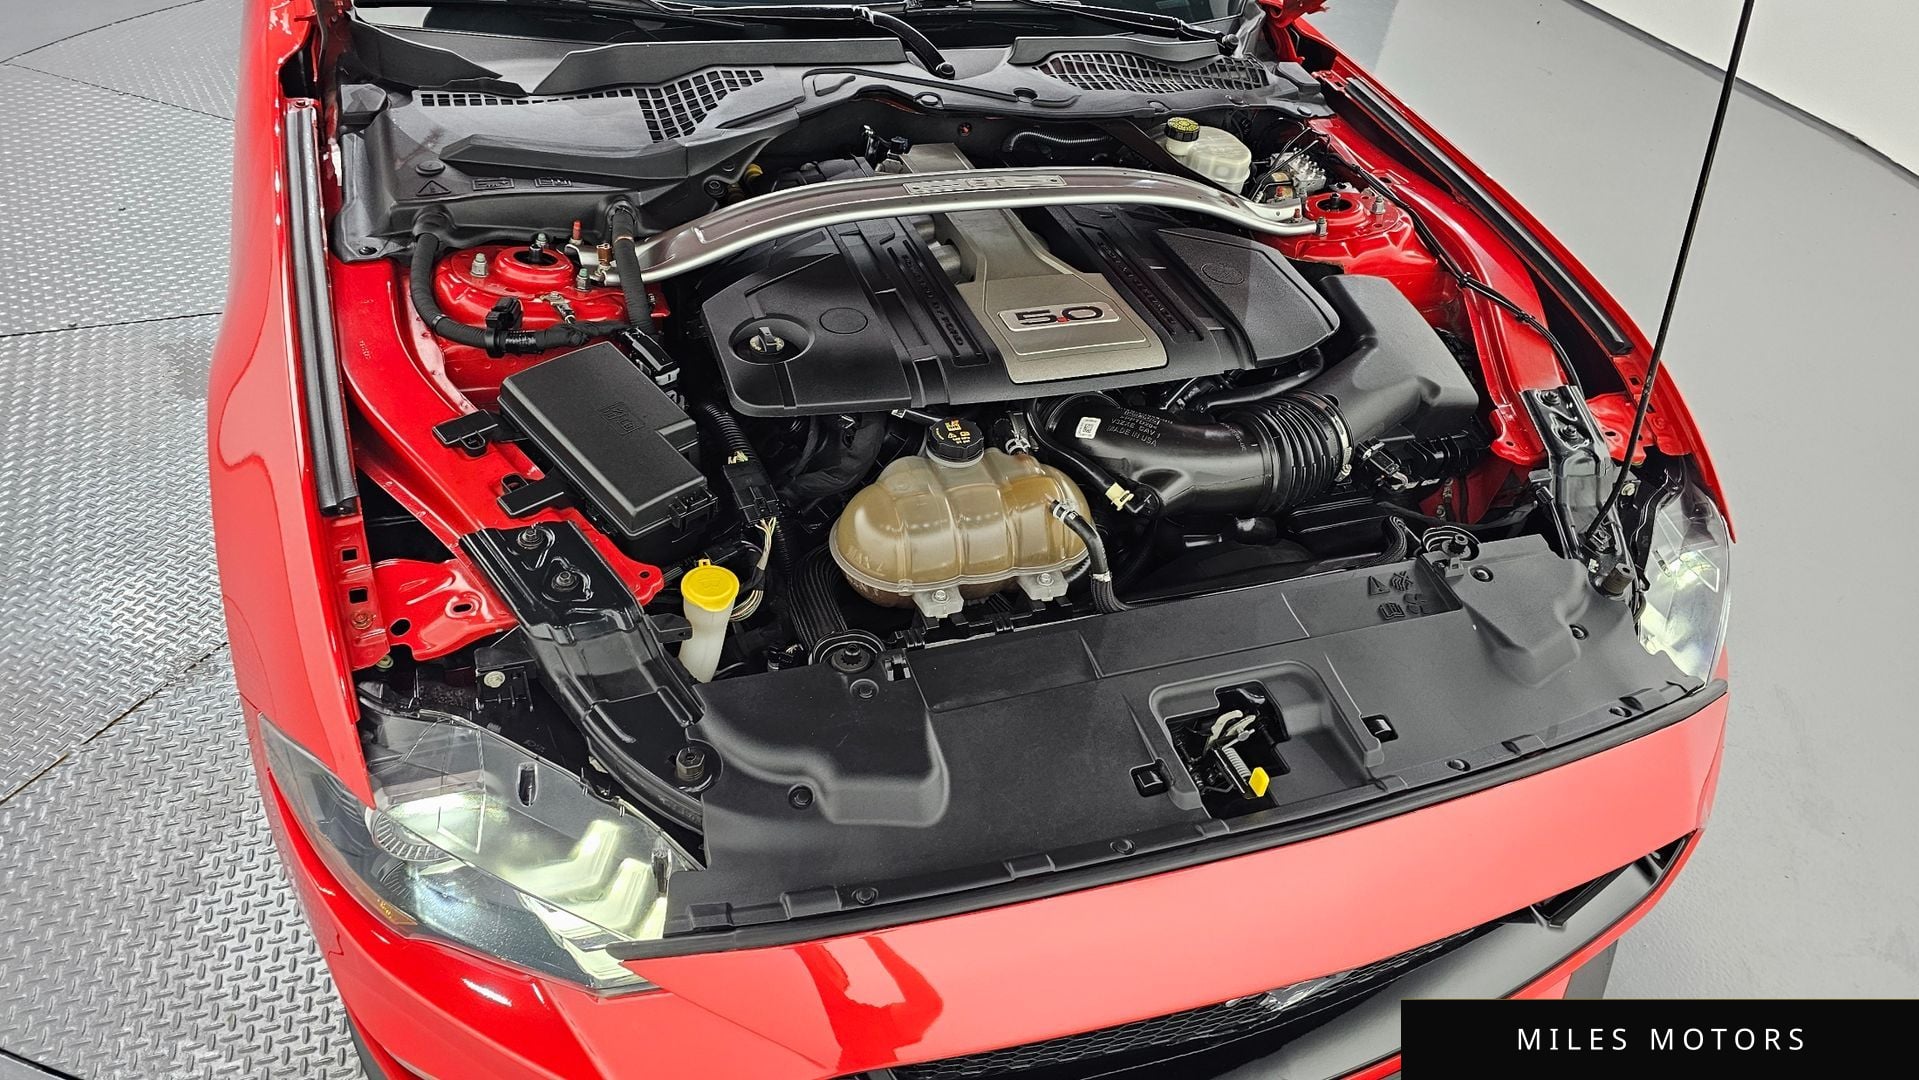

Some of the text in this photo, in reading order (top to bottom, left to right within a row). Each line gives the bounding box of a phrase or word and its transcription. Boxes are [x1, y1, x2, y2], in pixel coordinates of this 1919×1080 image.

[1014, 305, 1104, 326] 5.0
[1106, 426, 1131, 436] MADE
[1131, 431, 1140, 439] IN
[1141, 435, 1157, 447] USA
